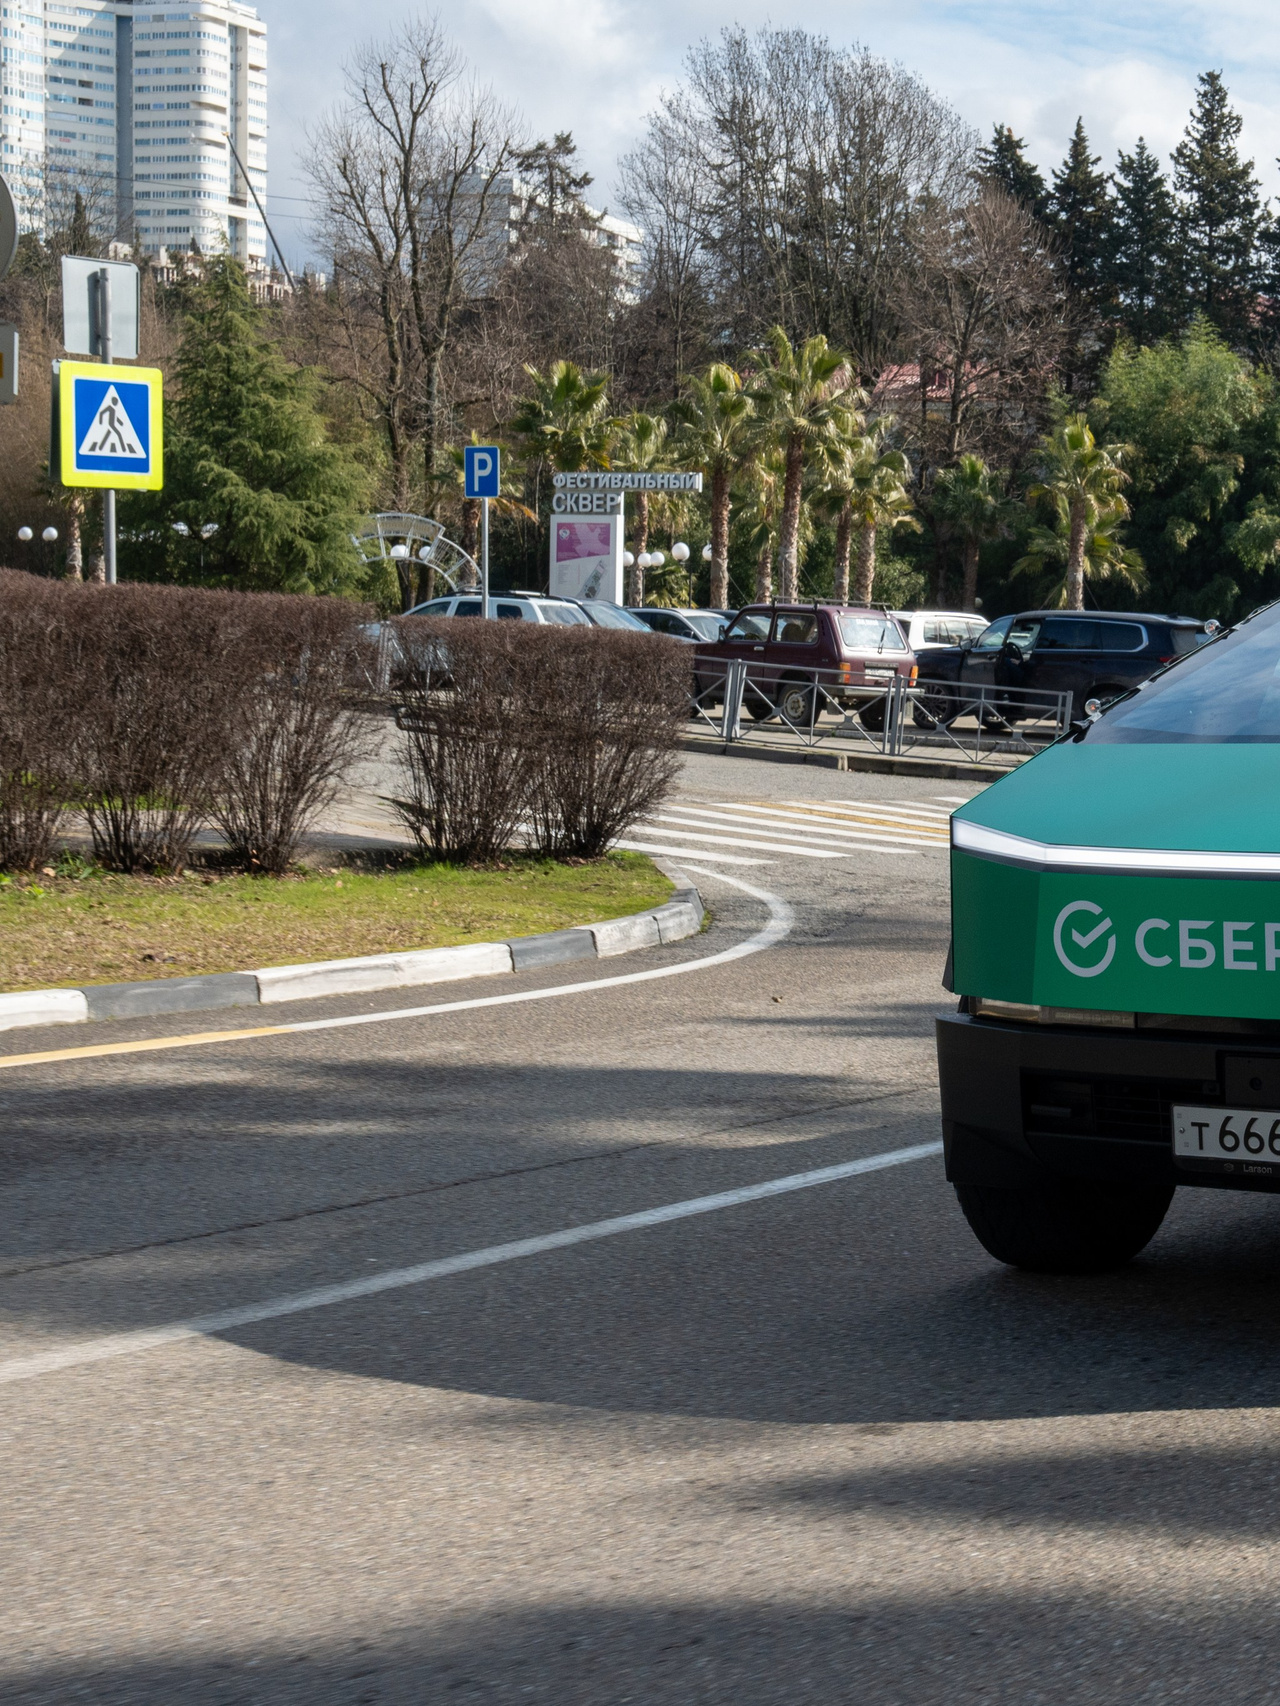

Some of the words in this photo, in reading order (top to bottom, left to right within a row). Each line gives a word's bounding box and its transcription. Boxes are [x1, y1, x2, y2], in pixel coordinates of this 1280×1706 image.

[474, 452, 493, 493] P
[552, 473, 698, 489] ФЕСТИВАЛЬНЫЙ
[552, 492, 621, 513] СКВЕР
[1243, 1164, 1273, 1174] Larson
